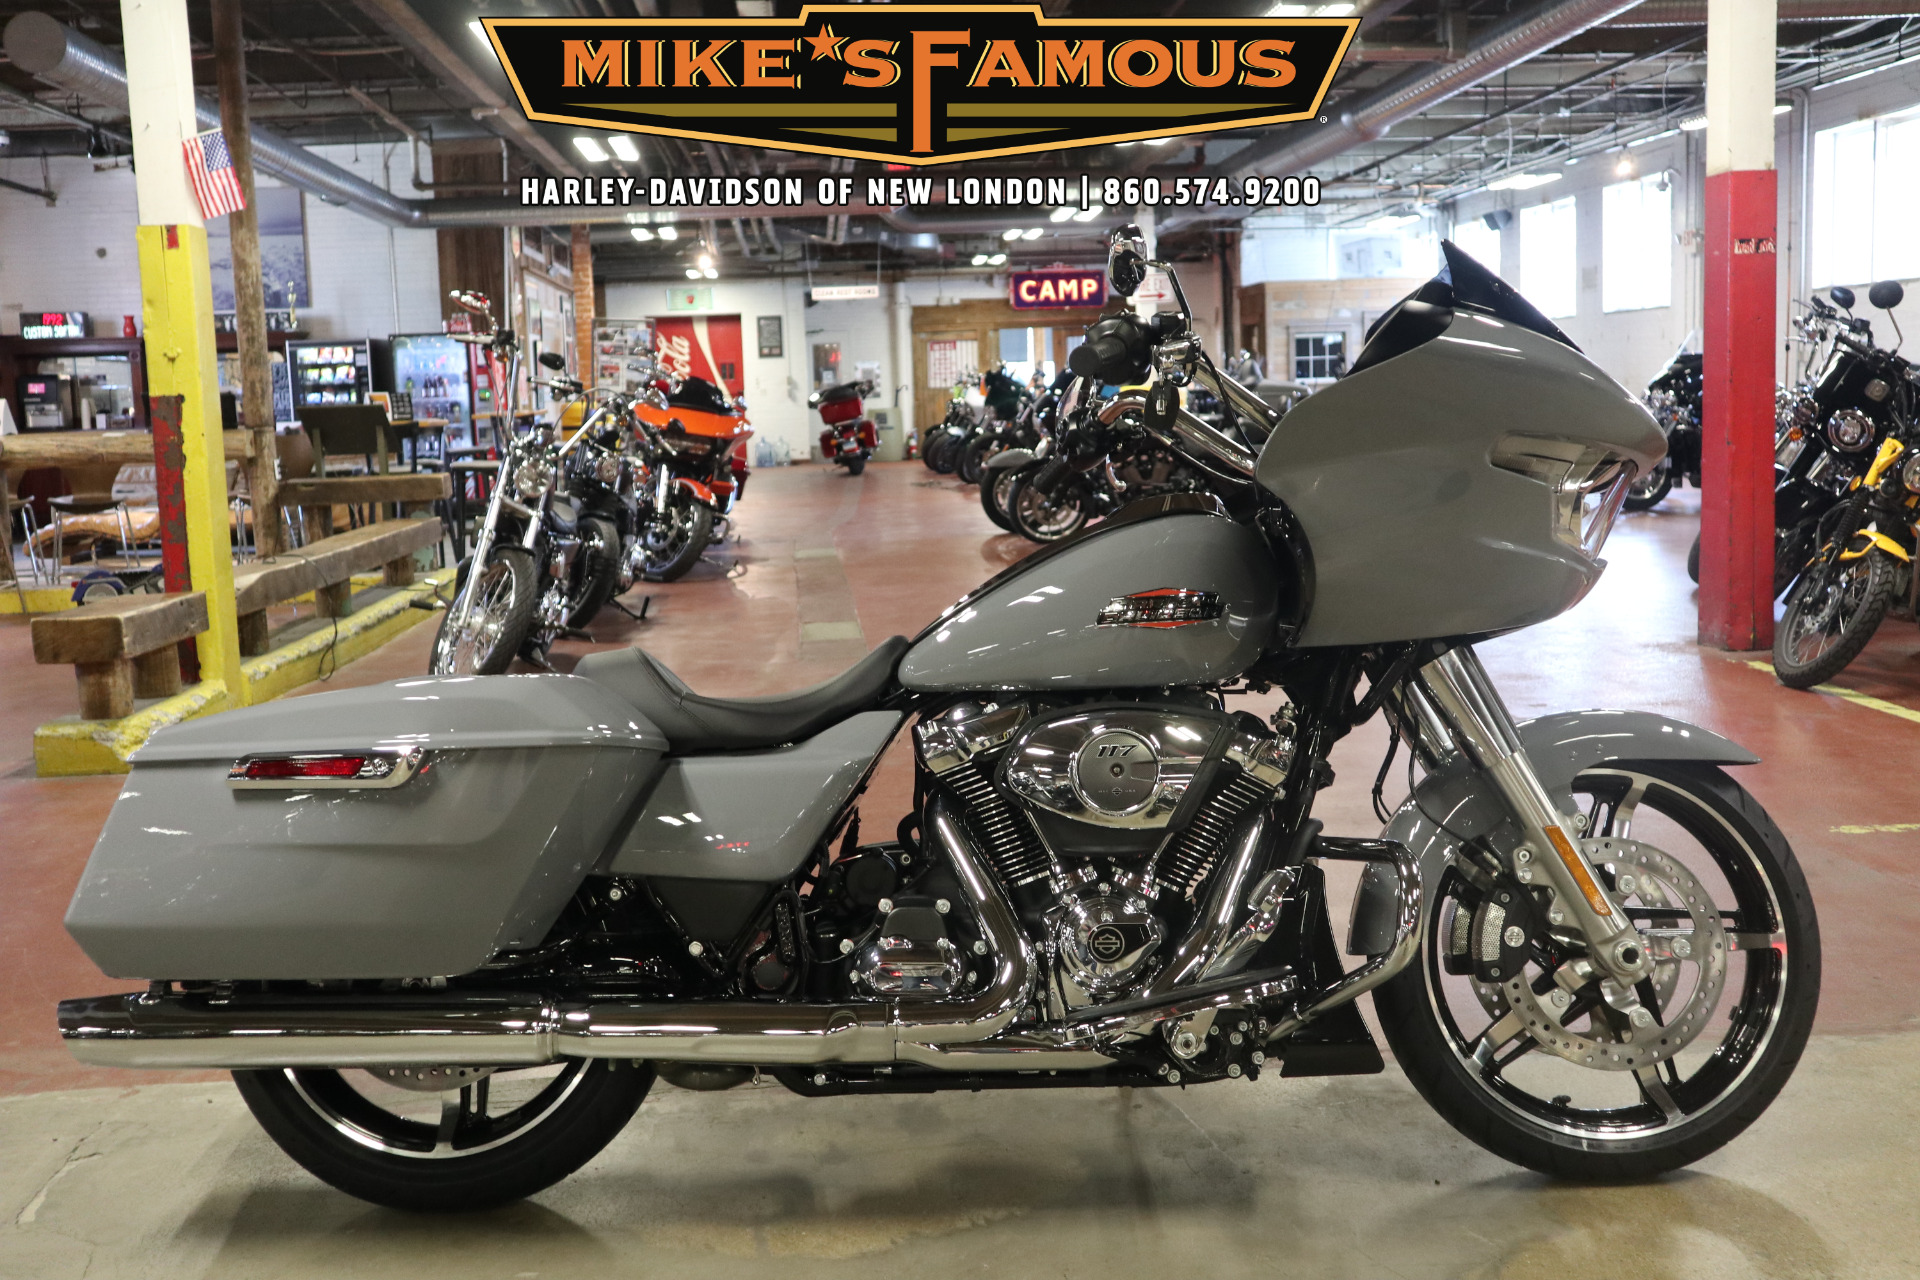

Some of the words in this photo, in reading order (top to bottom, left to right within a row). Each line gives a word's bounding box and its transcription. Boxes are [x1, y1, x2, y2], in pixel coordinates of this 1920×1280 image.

[1019, 278, 1099, 302] CAMP
[43, 313, 64, 326] 1992
[1097, 744, 1139, 758] 117
